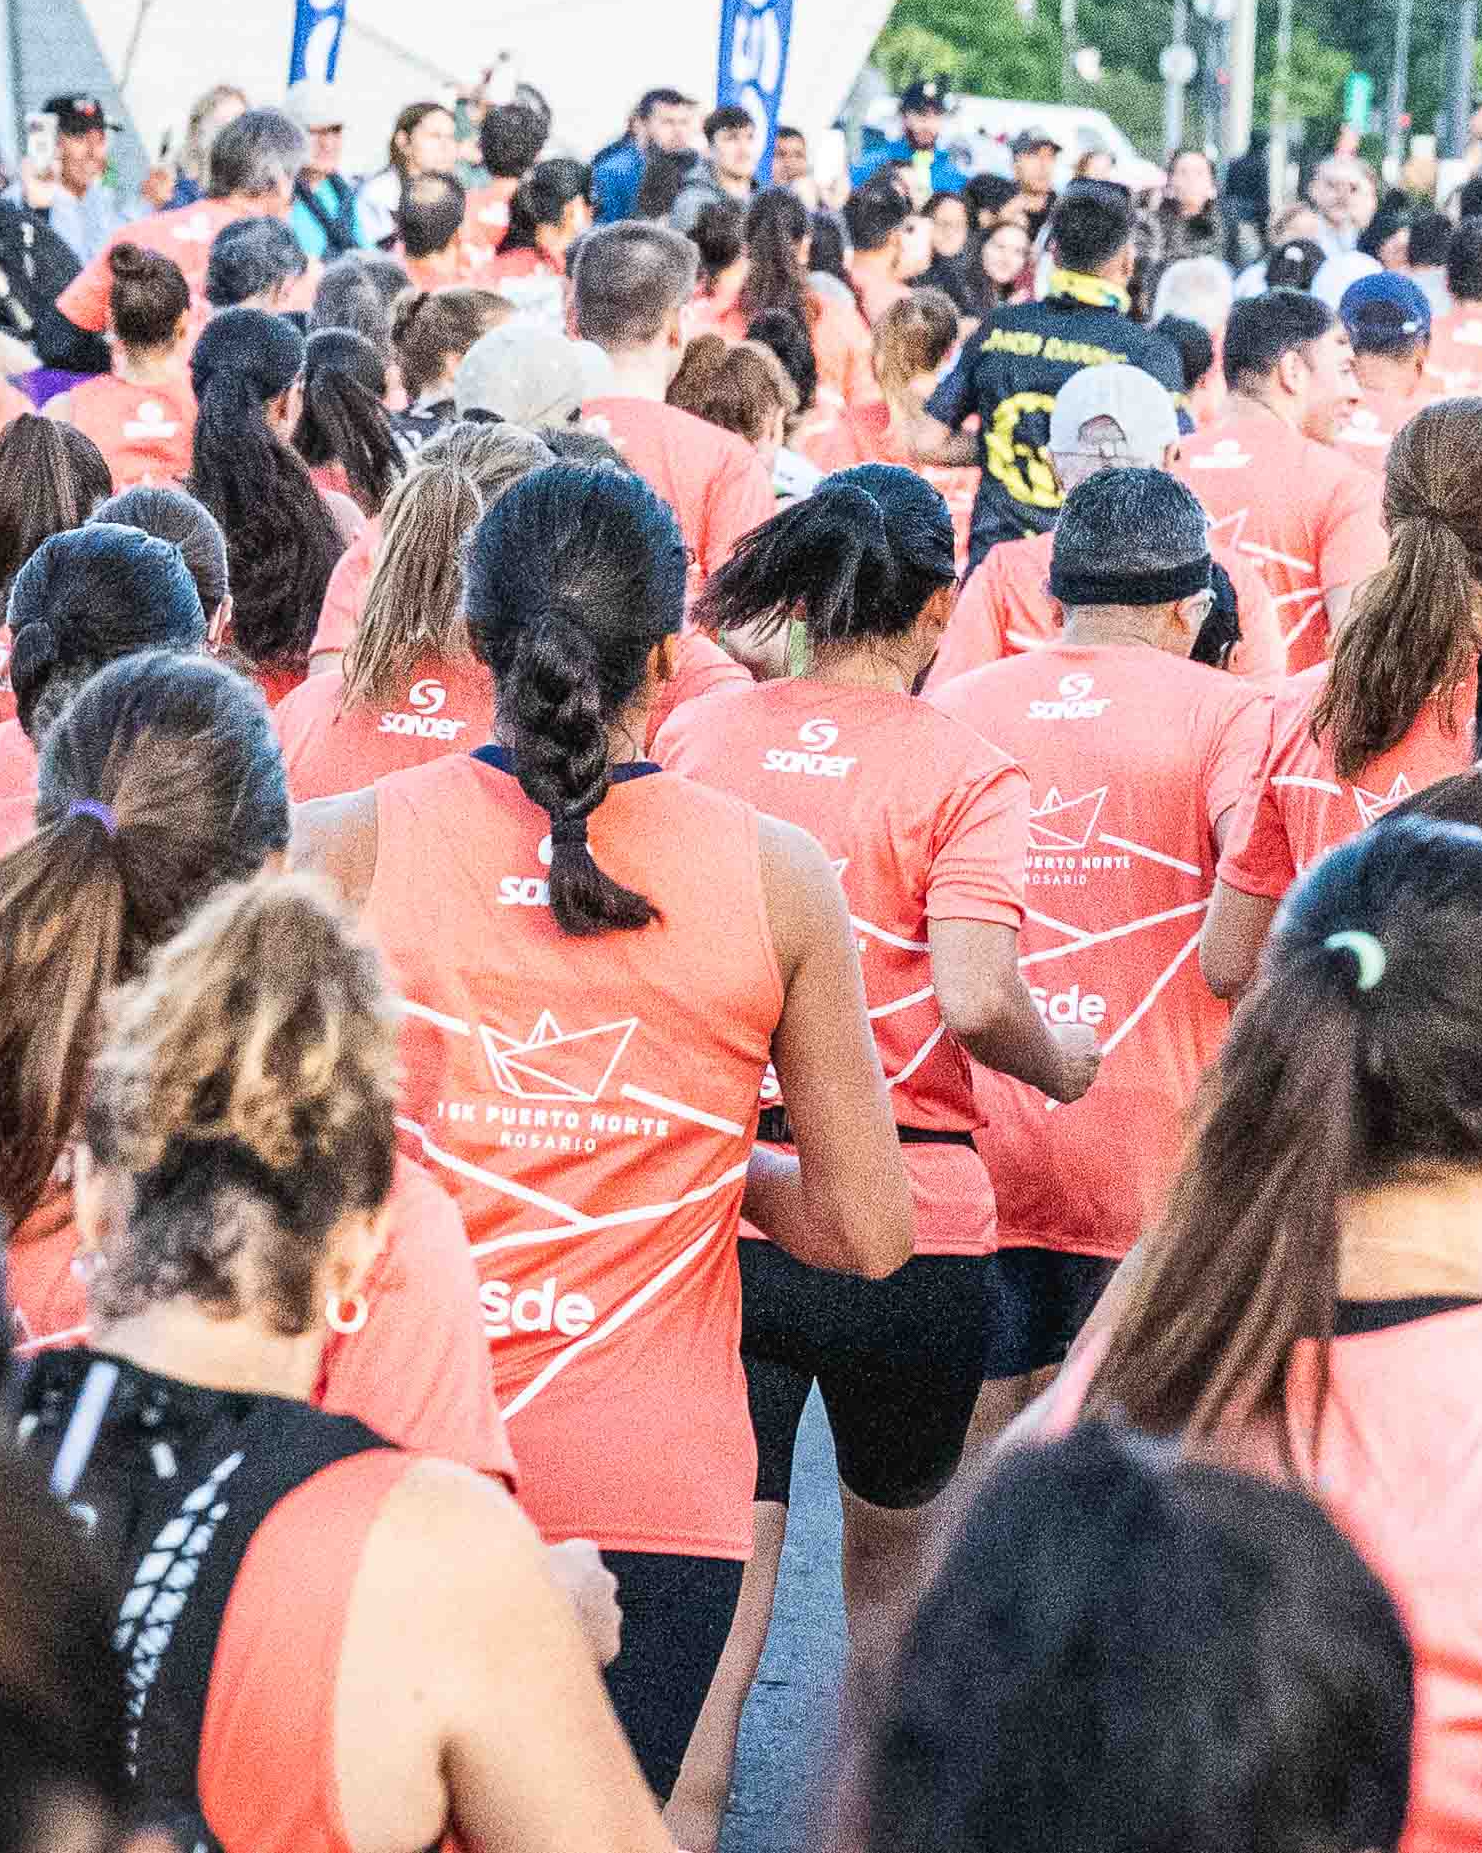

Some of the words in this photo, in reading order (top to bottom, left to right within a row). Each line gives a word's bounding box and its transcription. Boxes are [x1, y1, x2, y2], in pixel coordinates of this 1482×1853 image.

[485, 1105, 581, 1130] PUERTO
[589, 1113, 672, 1137] NORTE
[499, 1130, 598, 1154] ROSARIO
[478, 1277, 597, 1338] sde
